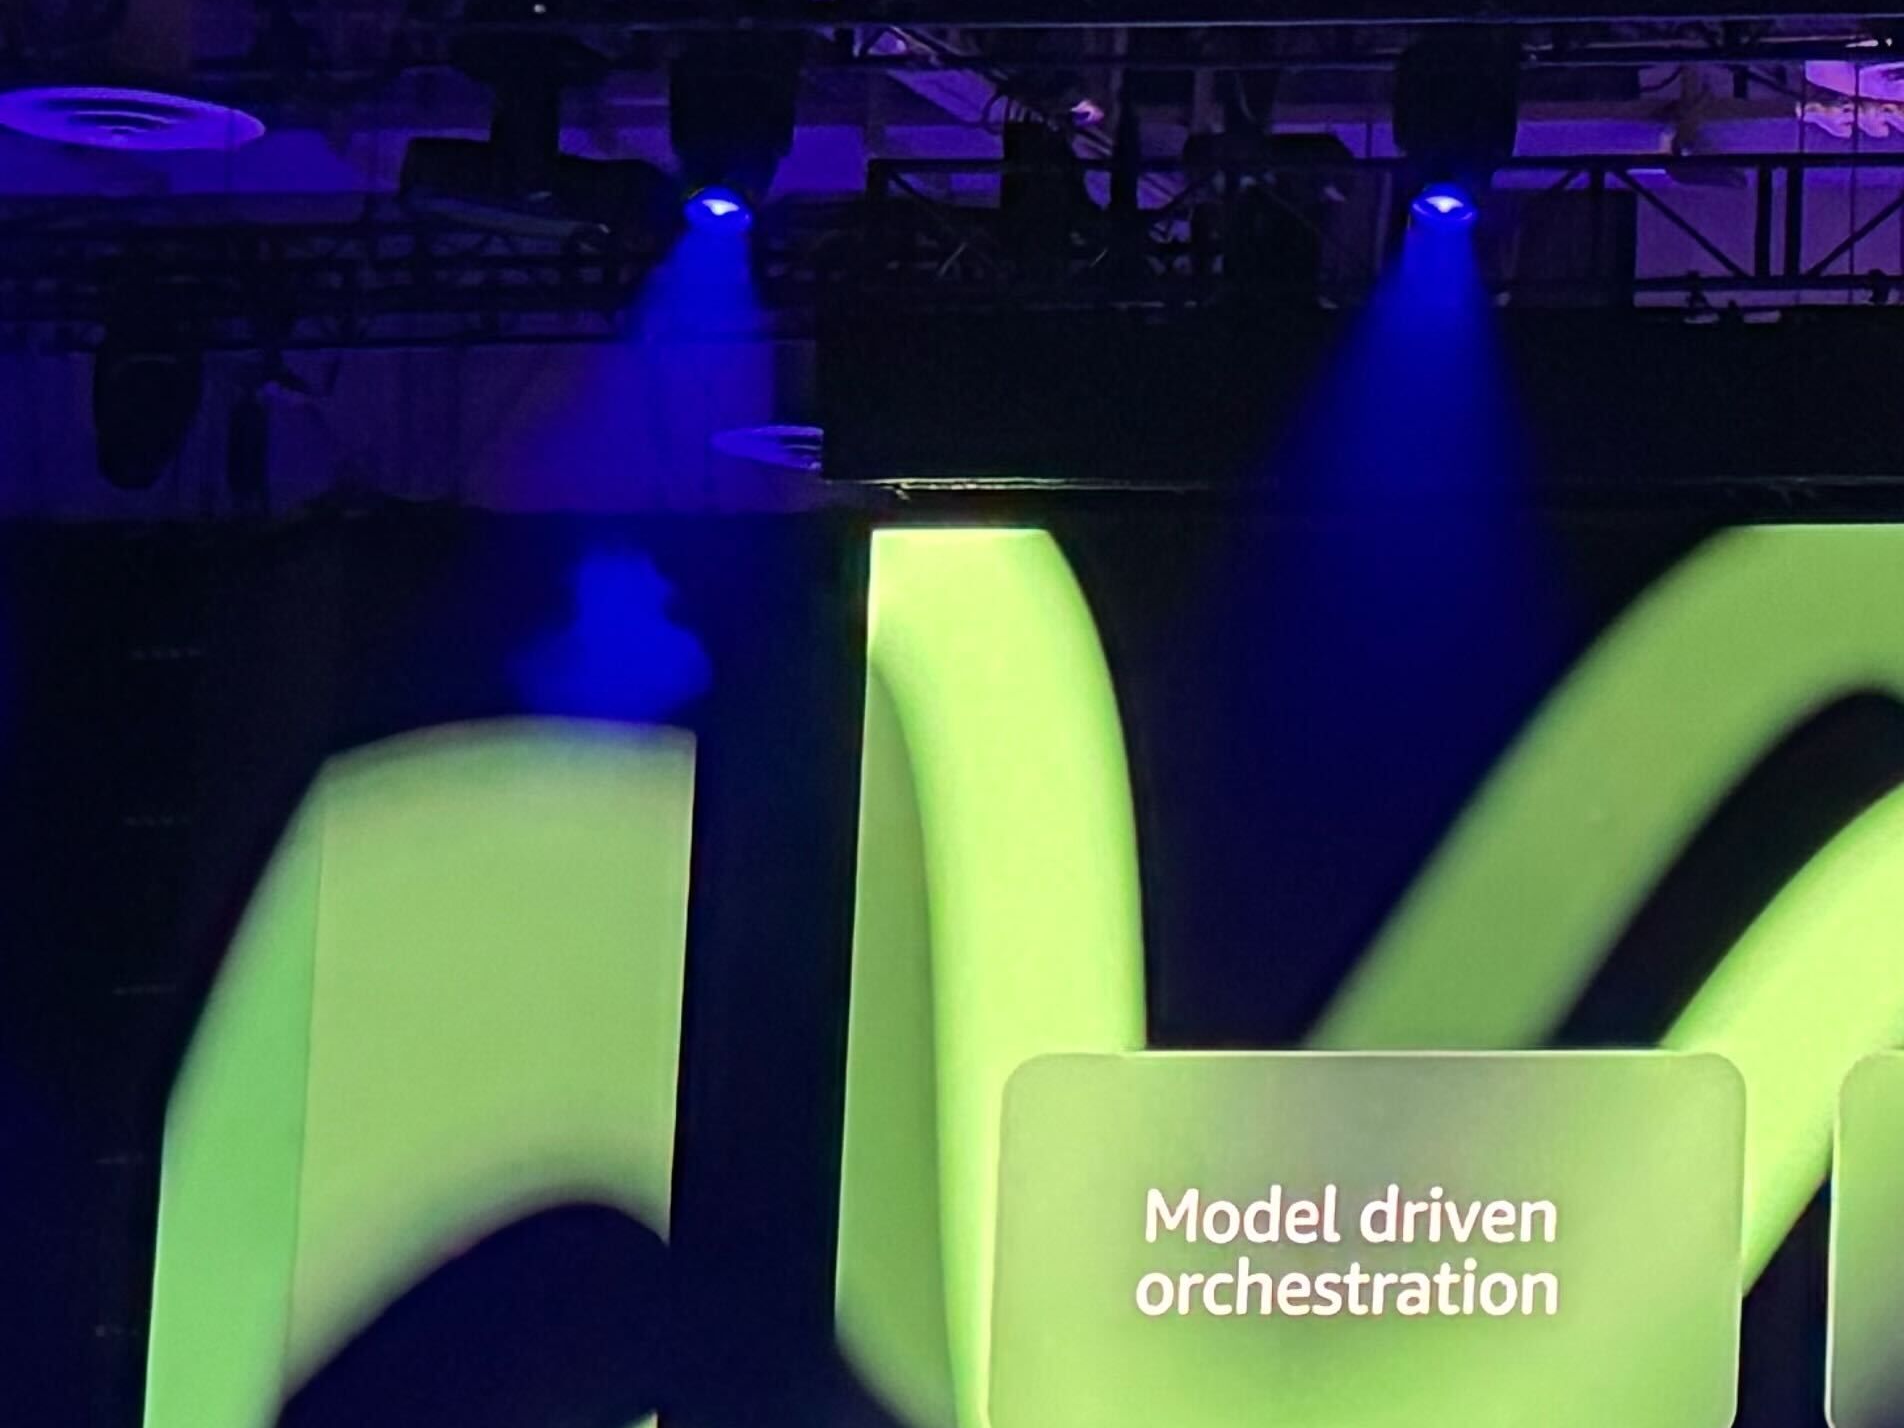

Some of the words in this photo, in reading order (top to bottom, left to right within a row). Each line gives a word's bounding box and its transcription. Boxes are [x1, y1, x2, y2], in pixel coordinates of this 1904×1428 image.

[1145, 1183, 1341, 1245] Model
[1359, 1182, 1557, 1244] driven
[1135, 1256, 1558, 1316] orchestration
